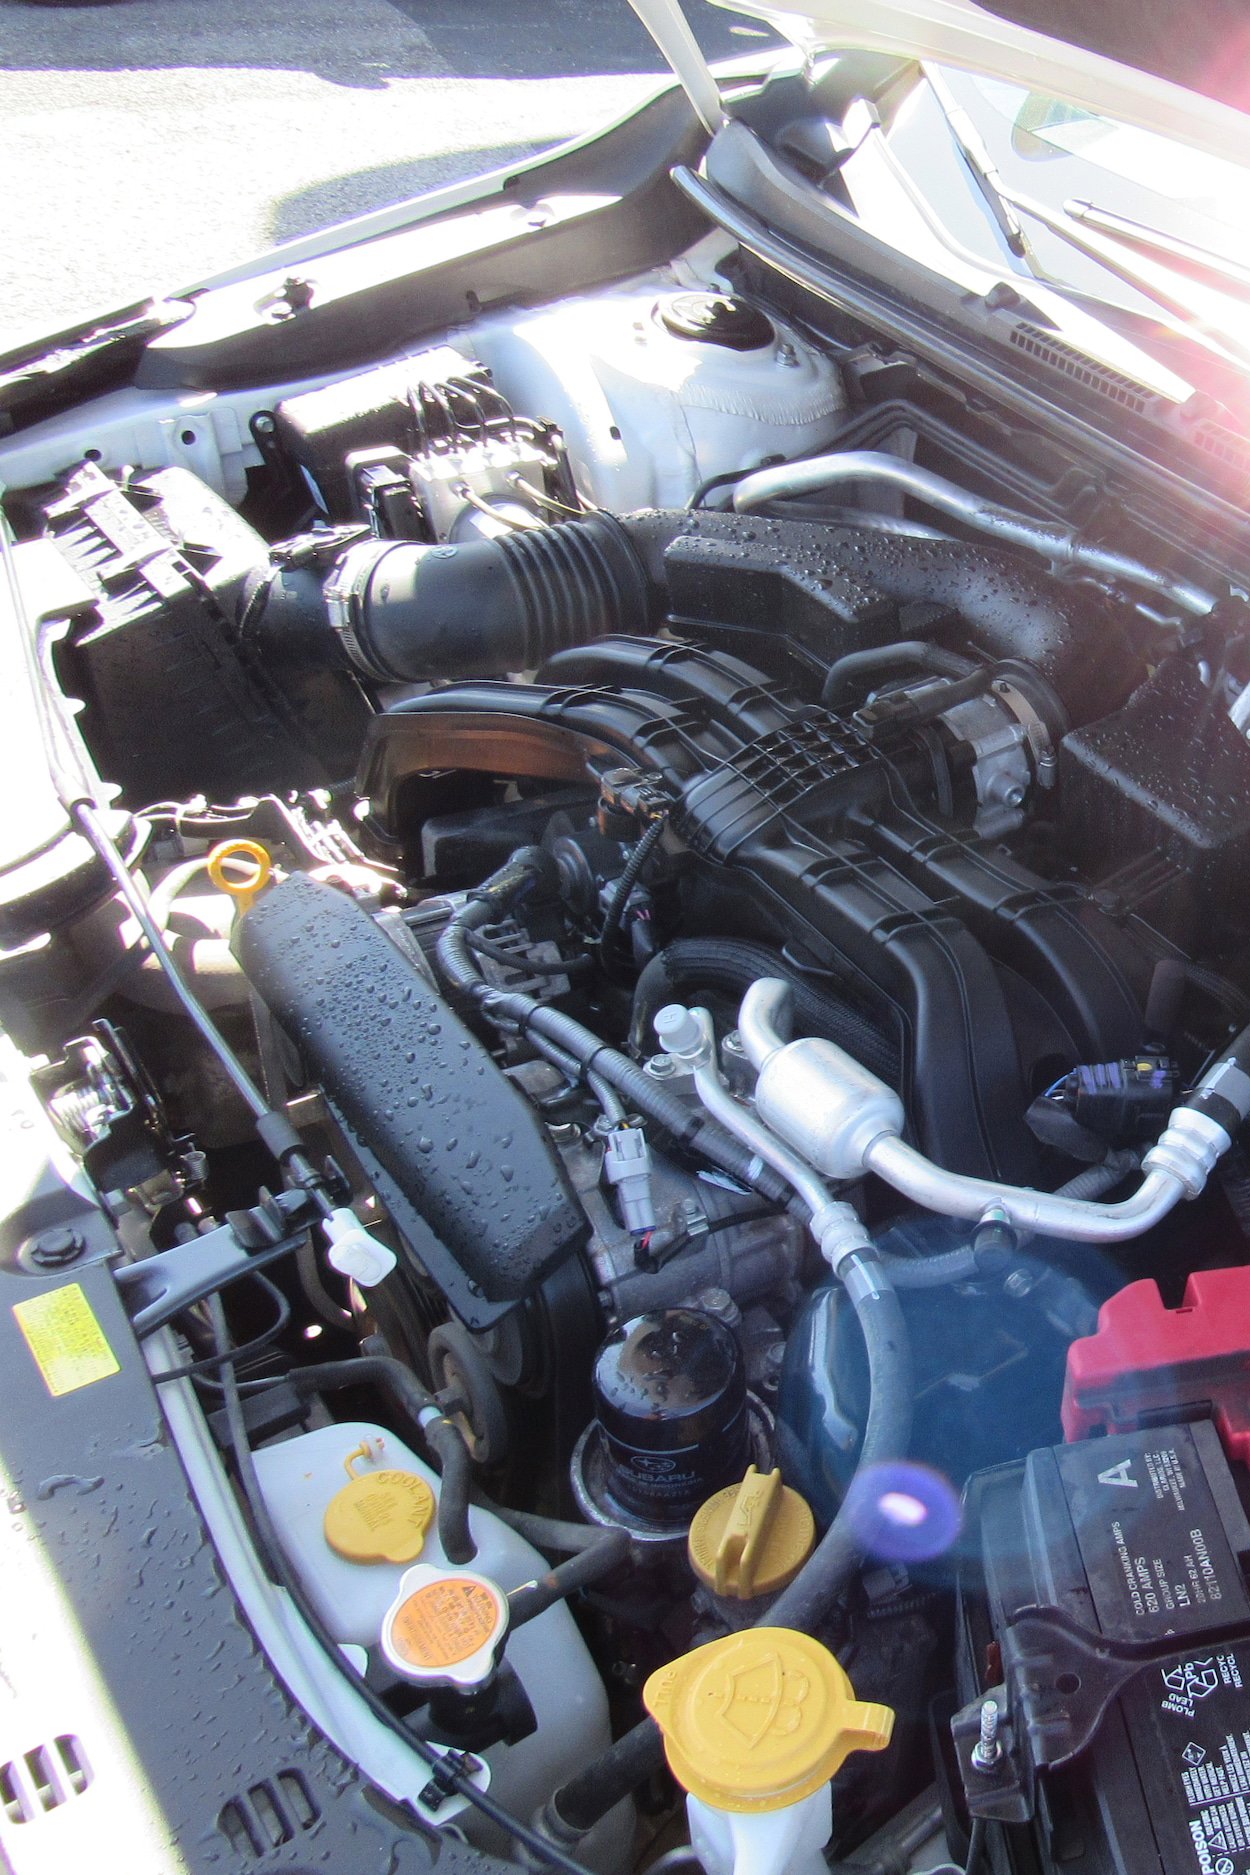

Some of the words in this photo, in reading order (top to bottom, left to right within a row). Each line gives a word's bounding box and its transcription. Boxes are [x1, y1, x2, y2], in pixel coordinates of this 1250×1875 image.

[1097, 1458, 1139, 1489] A
[378, 1472, 430, 1528] COOLANT
[1111, 1520, 1125, 1544] AMPS
[1117, 1545, 1138, 1590] CRANKING
[1152, 1558, 1165, 1577] SIZE
[1184, 1554, 1194, 1567] AH
[1189, 1527, 1222, 1600] 82110AN00B
[1134, 1556, 1153, 1590] AMPS
[1188, 1567, 1198, 1579] 62
[1130, 1591, 1145, 1615] COLD
[1144, 1592, 1159, 1613] 620
[1158, 1578, 1175, 1609] GROUP
[1174, 1582, 1190, 1606] LN2
[1184, 1662, 1197, 1679] Pb
[1161, 1700, 1195, 1716] PLOMB
[1168, 1692, 1193, 1706] LEAD
[1189, 1819, 1215, 1875] POISON
